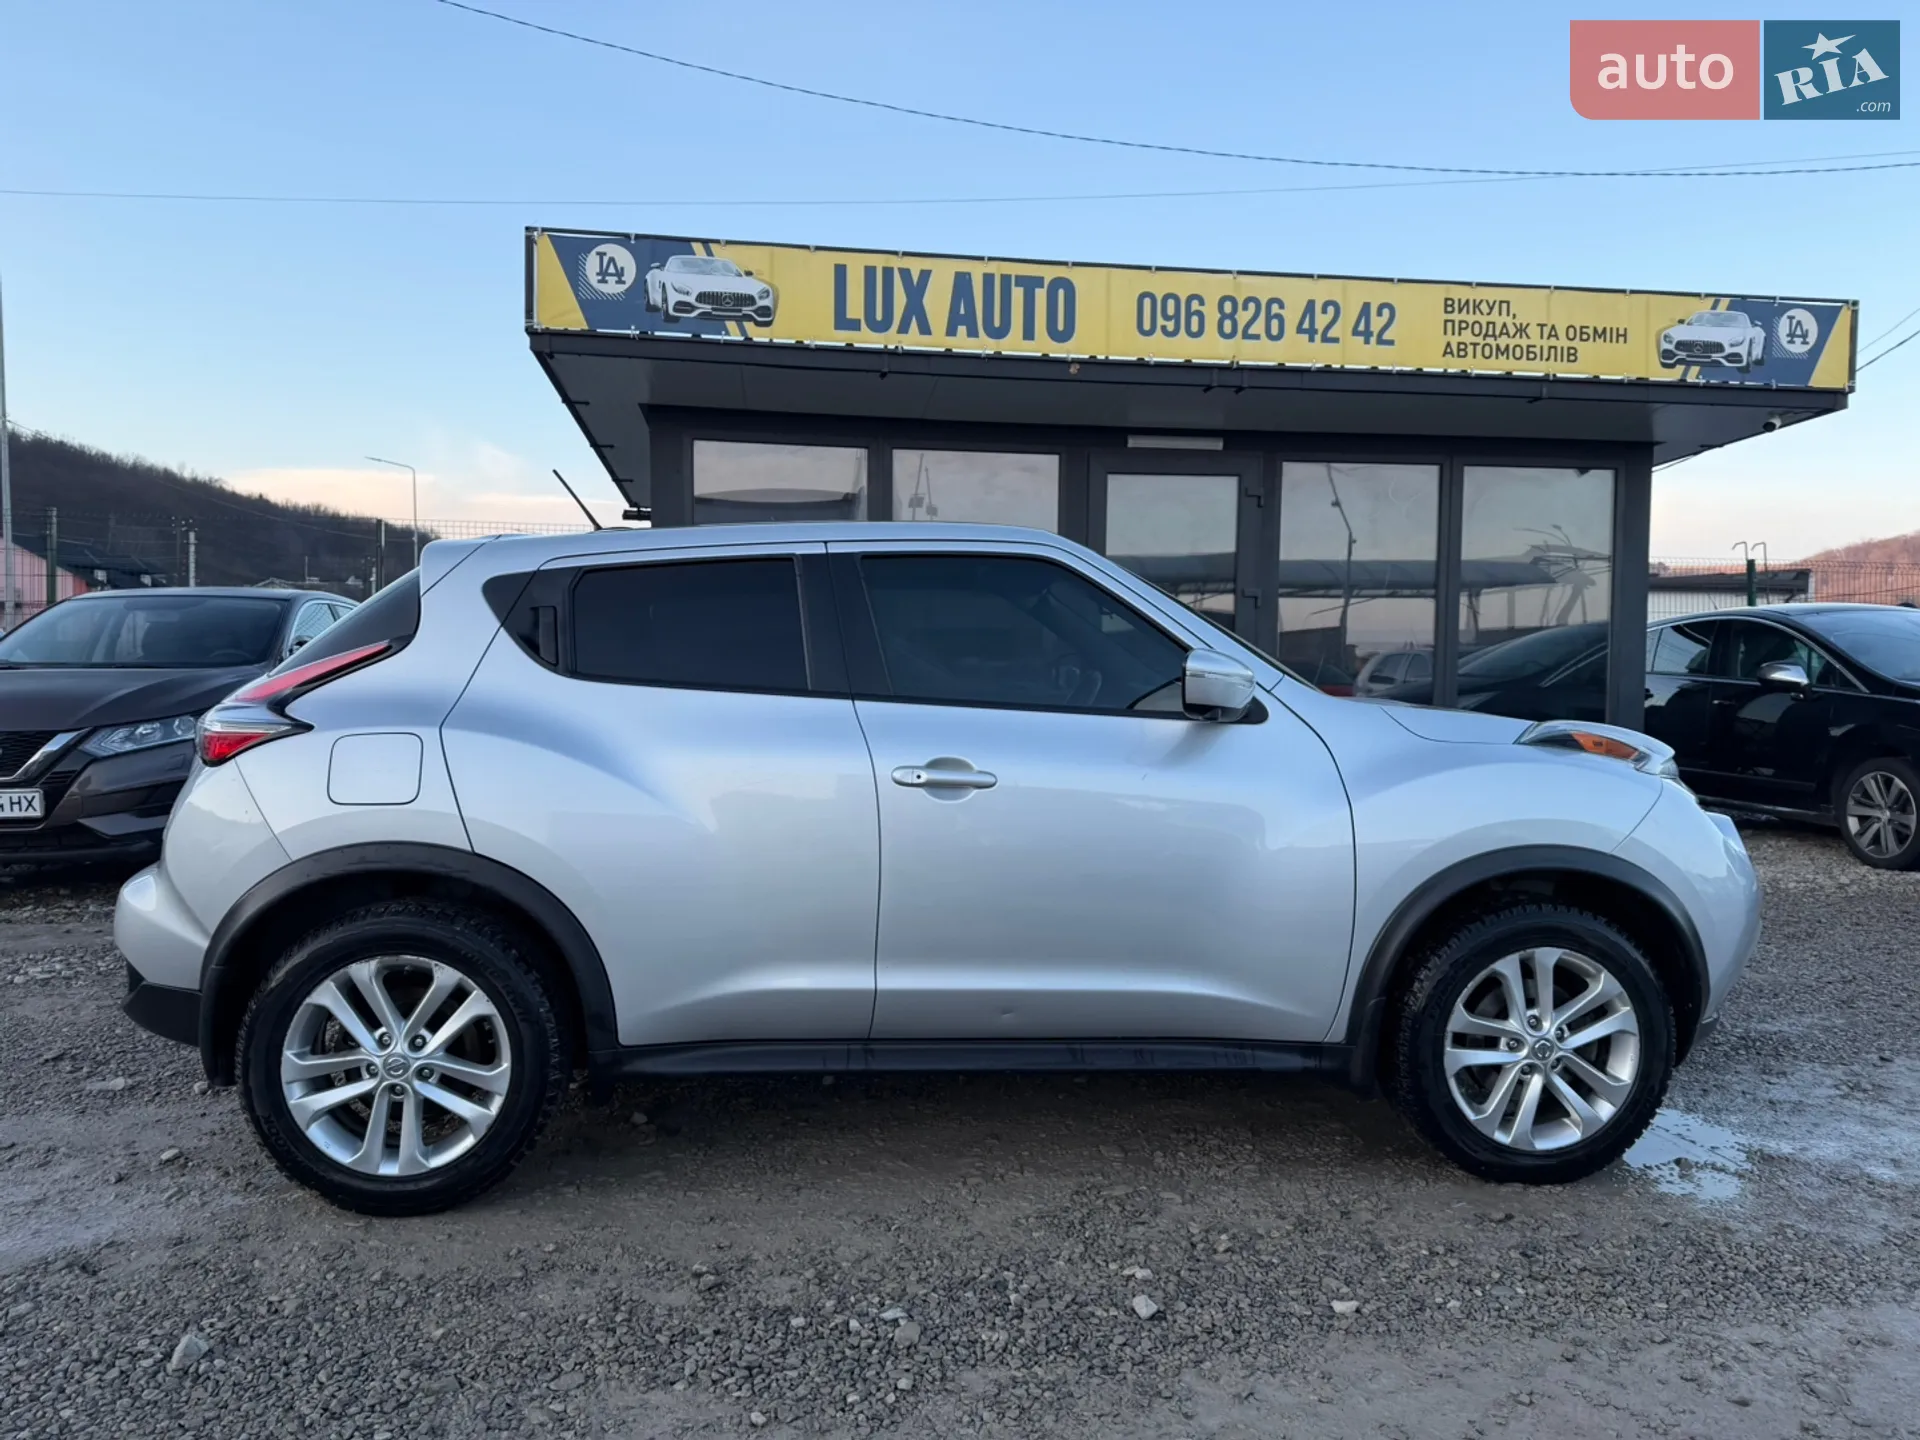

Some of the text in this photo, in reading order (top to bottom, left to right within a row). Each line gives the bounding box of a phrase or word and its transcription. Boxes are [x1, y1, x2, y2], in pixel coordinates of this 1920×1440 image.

[833, 263, 1076, 344] LUX AUTO
[1443, 297, 1517, 319] ВИКУП,
[1136, 291, 1396, 346] 096 826 42 42
[1443, 318, 1628, 344] ПРОДАЖ ТА ОБМІН
[1442, 341, 1579, 363] АВТОМОБІЛІВ
